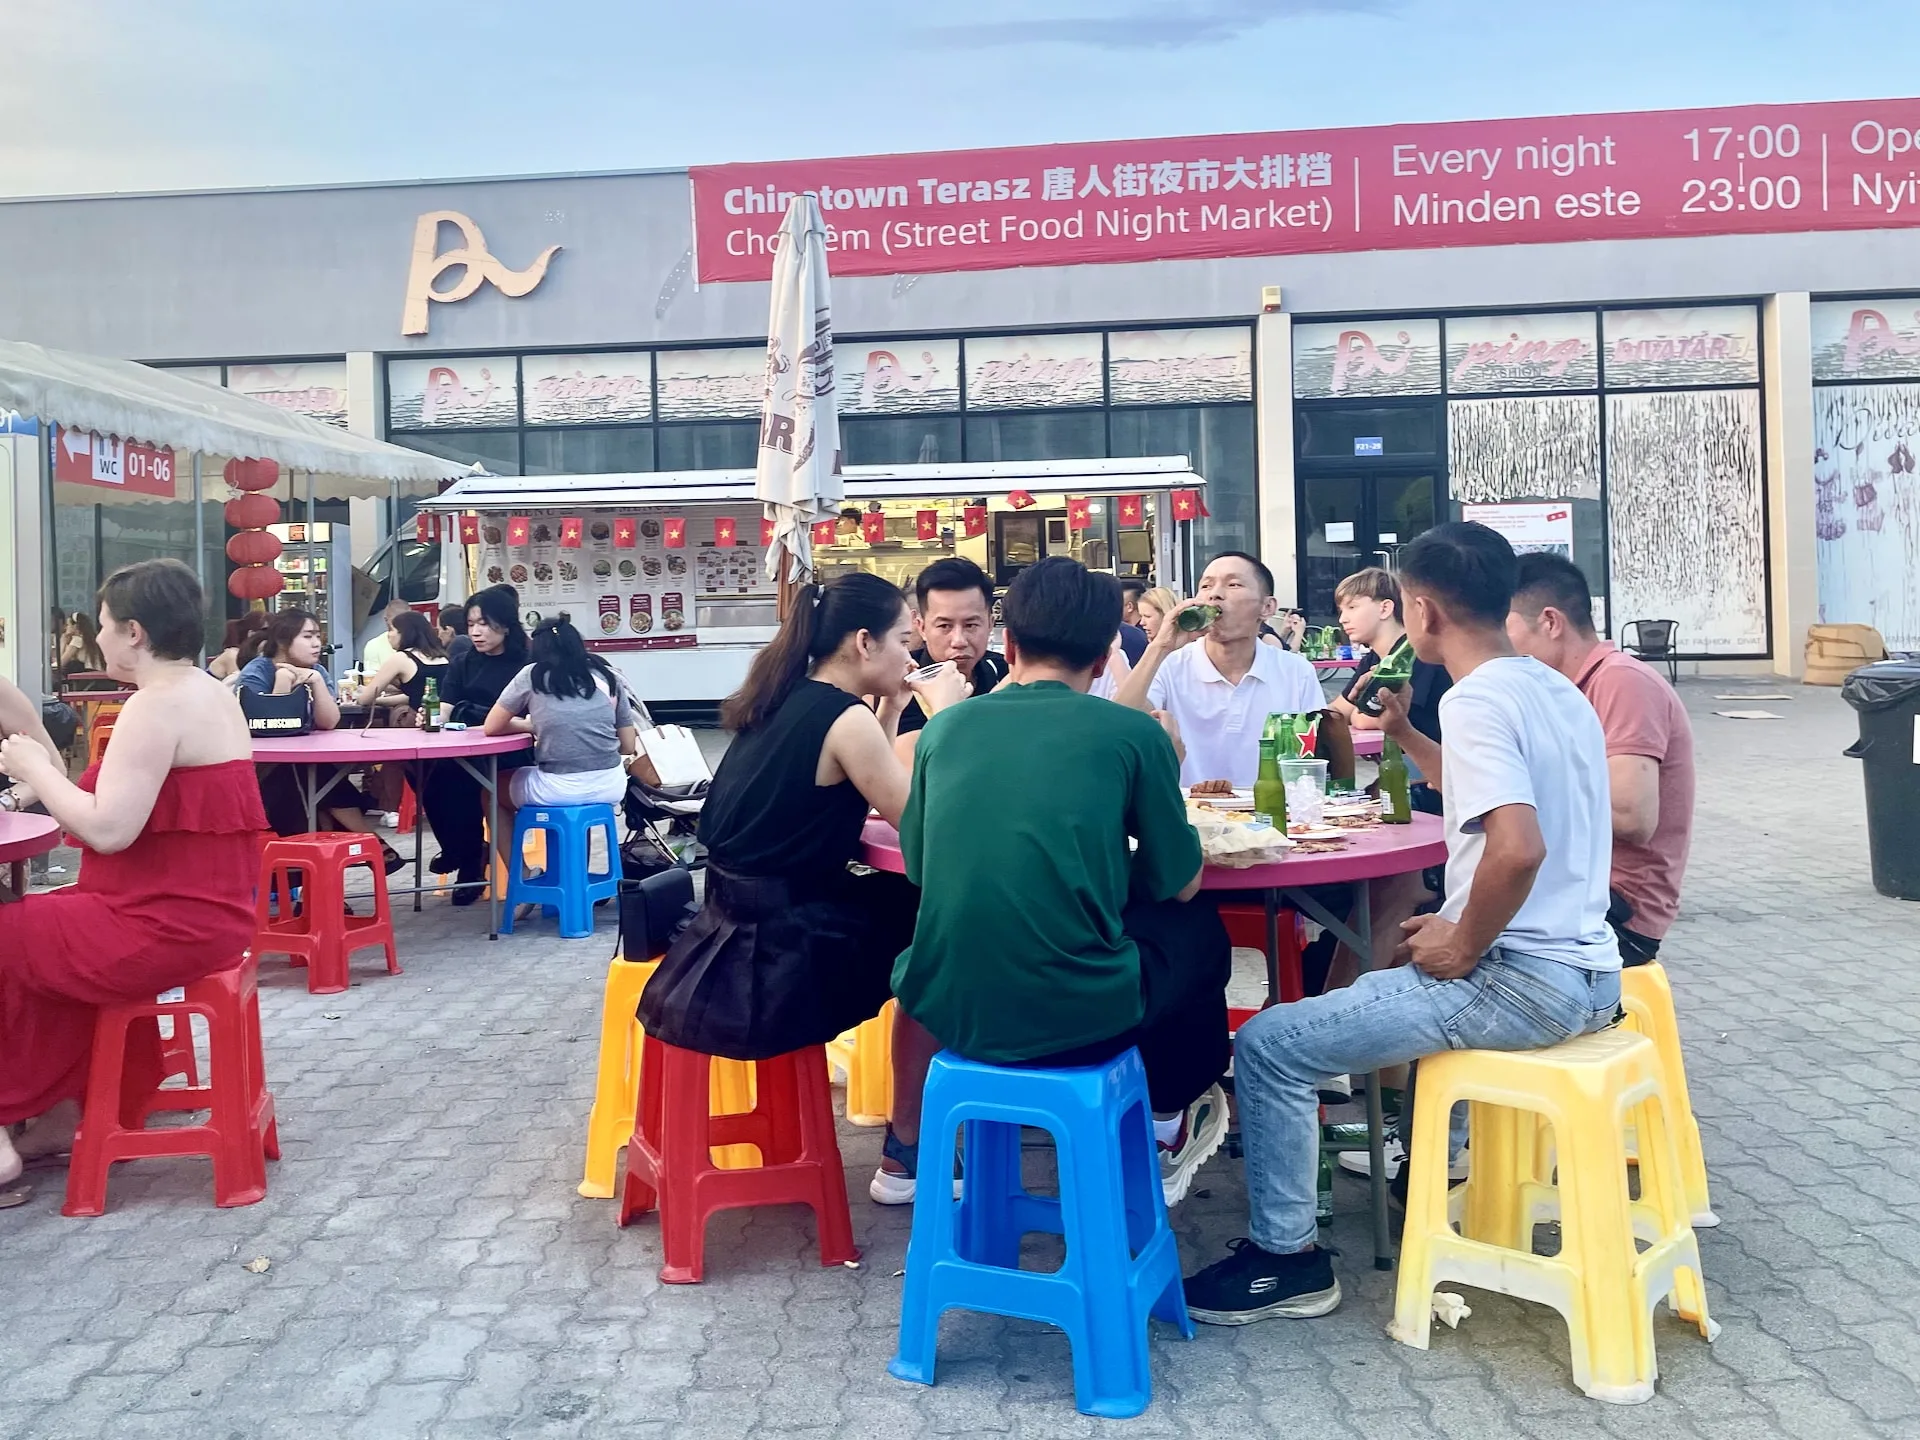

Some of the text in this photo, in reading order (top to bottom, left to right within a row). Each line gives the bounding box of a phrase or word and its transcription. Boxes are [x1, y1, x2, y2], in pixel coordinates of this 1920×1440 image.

[1393, 135, 1617, 180] Every night
[1683, 123, 1800, 161] 17:00
[1850, 120, 1920, 161] Op
[724, 178, 1031, 215] Chintown Terasz
[1042, 152, 1333, 201] 唐人街夜市大排档
[1682, 175, 1801, 213] 23:00
[1853, 171, 1920, 213] Nyi
[882, 220, 991, 256] (Street
[1001, 209, 1083, 243] Food
[1096, 205, 1190, 242] Night
[1201, 196, 1333, 232] Market)
[1393, 185, 1641, 226] Minden este
[100, 452, 171, 482] WC 01-06
[248, 718, 266, 729] LOVE
